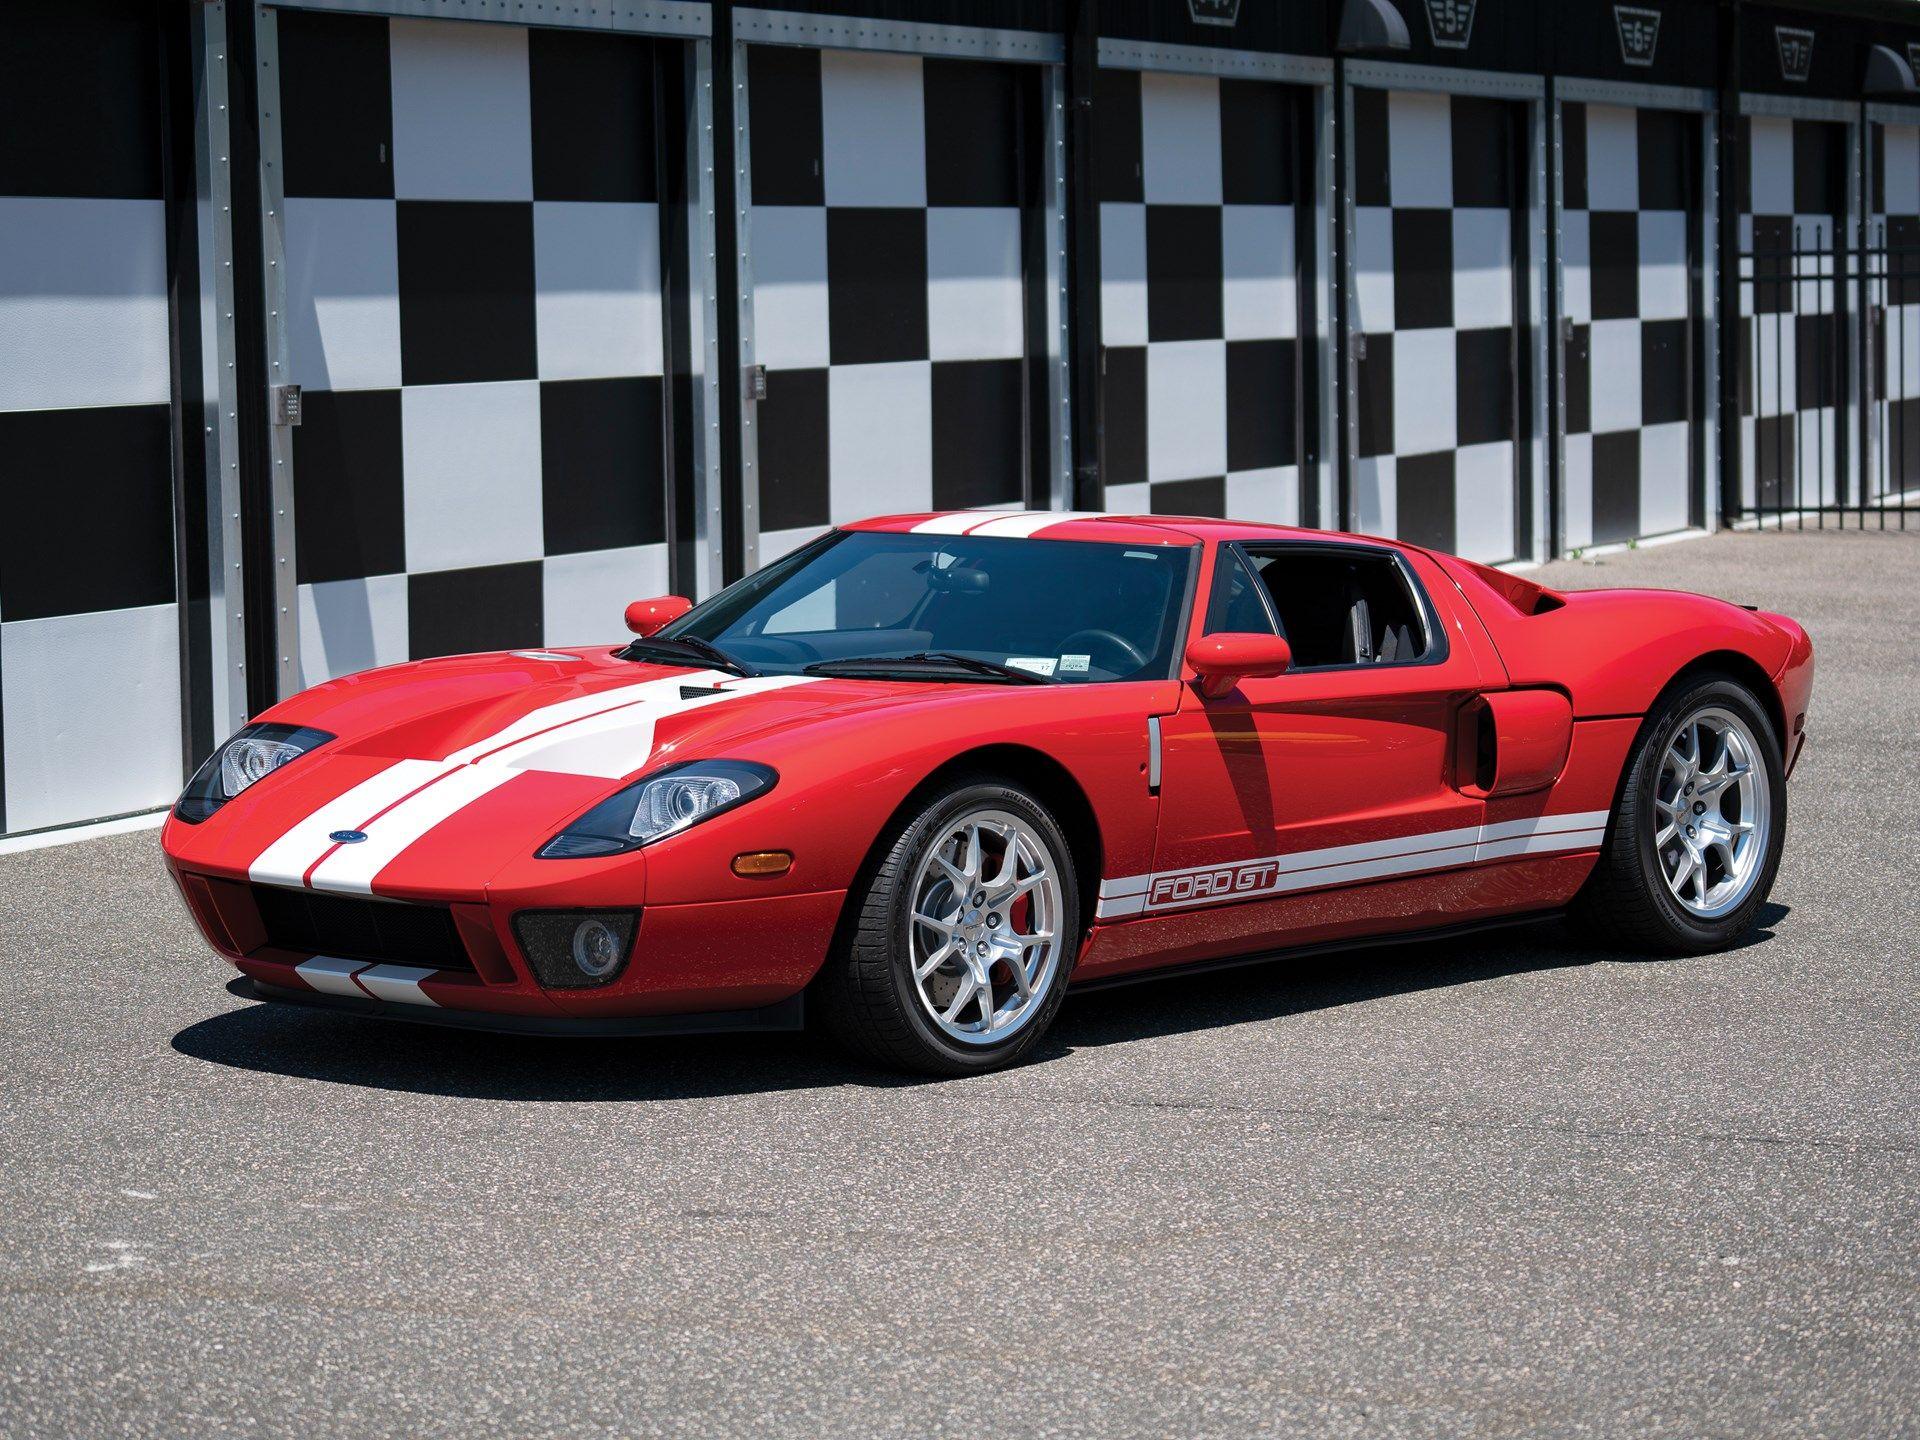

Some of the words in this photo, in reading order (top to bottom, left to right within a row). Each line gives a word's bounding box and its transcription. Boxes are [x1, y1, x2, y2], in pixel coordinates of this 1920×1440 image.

[1446, 0, 1456, 33] 5
[1634, 20, 1643, 52] 6
[1152, 870, 1233, 903] FORD
[1235, 863, 1277, 891] GT
